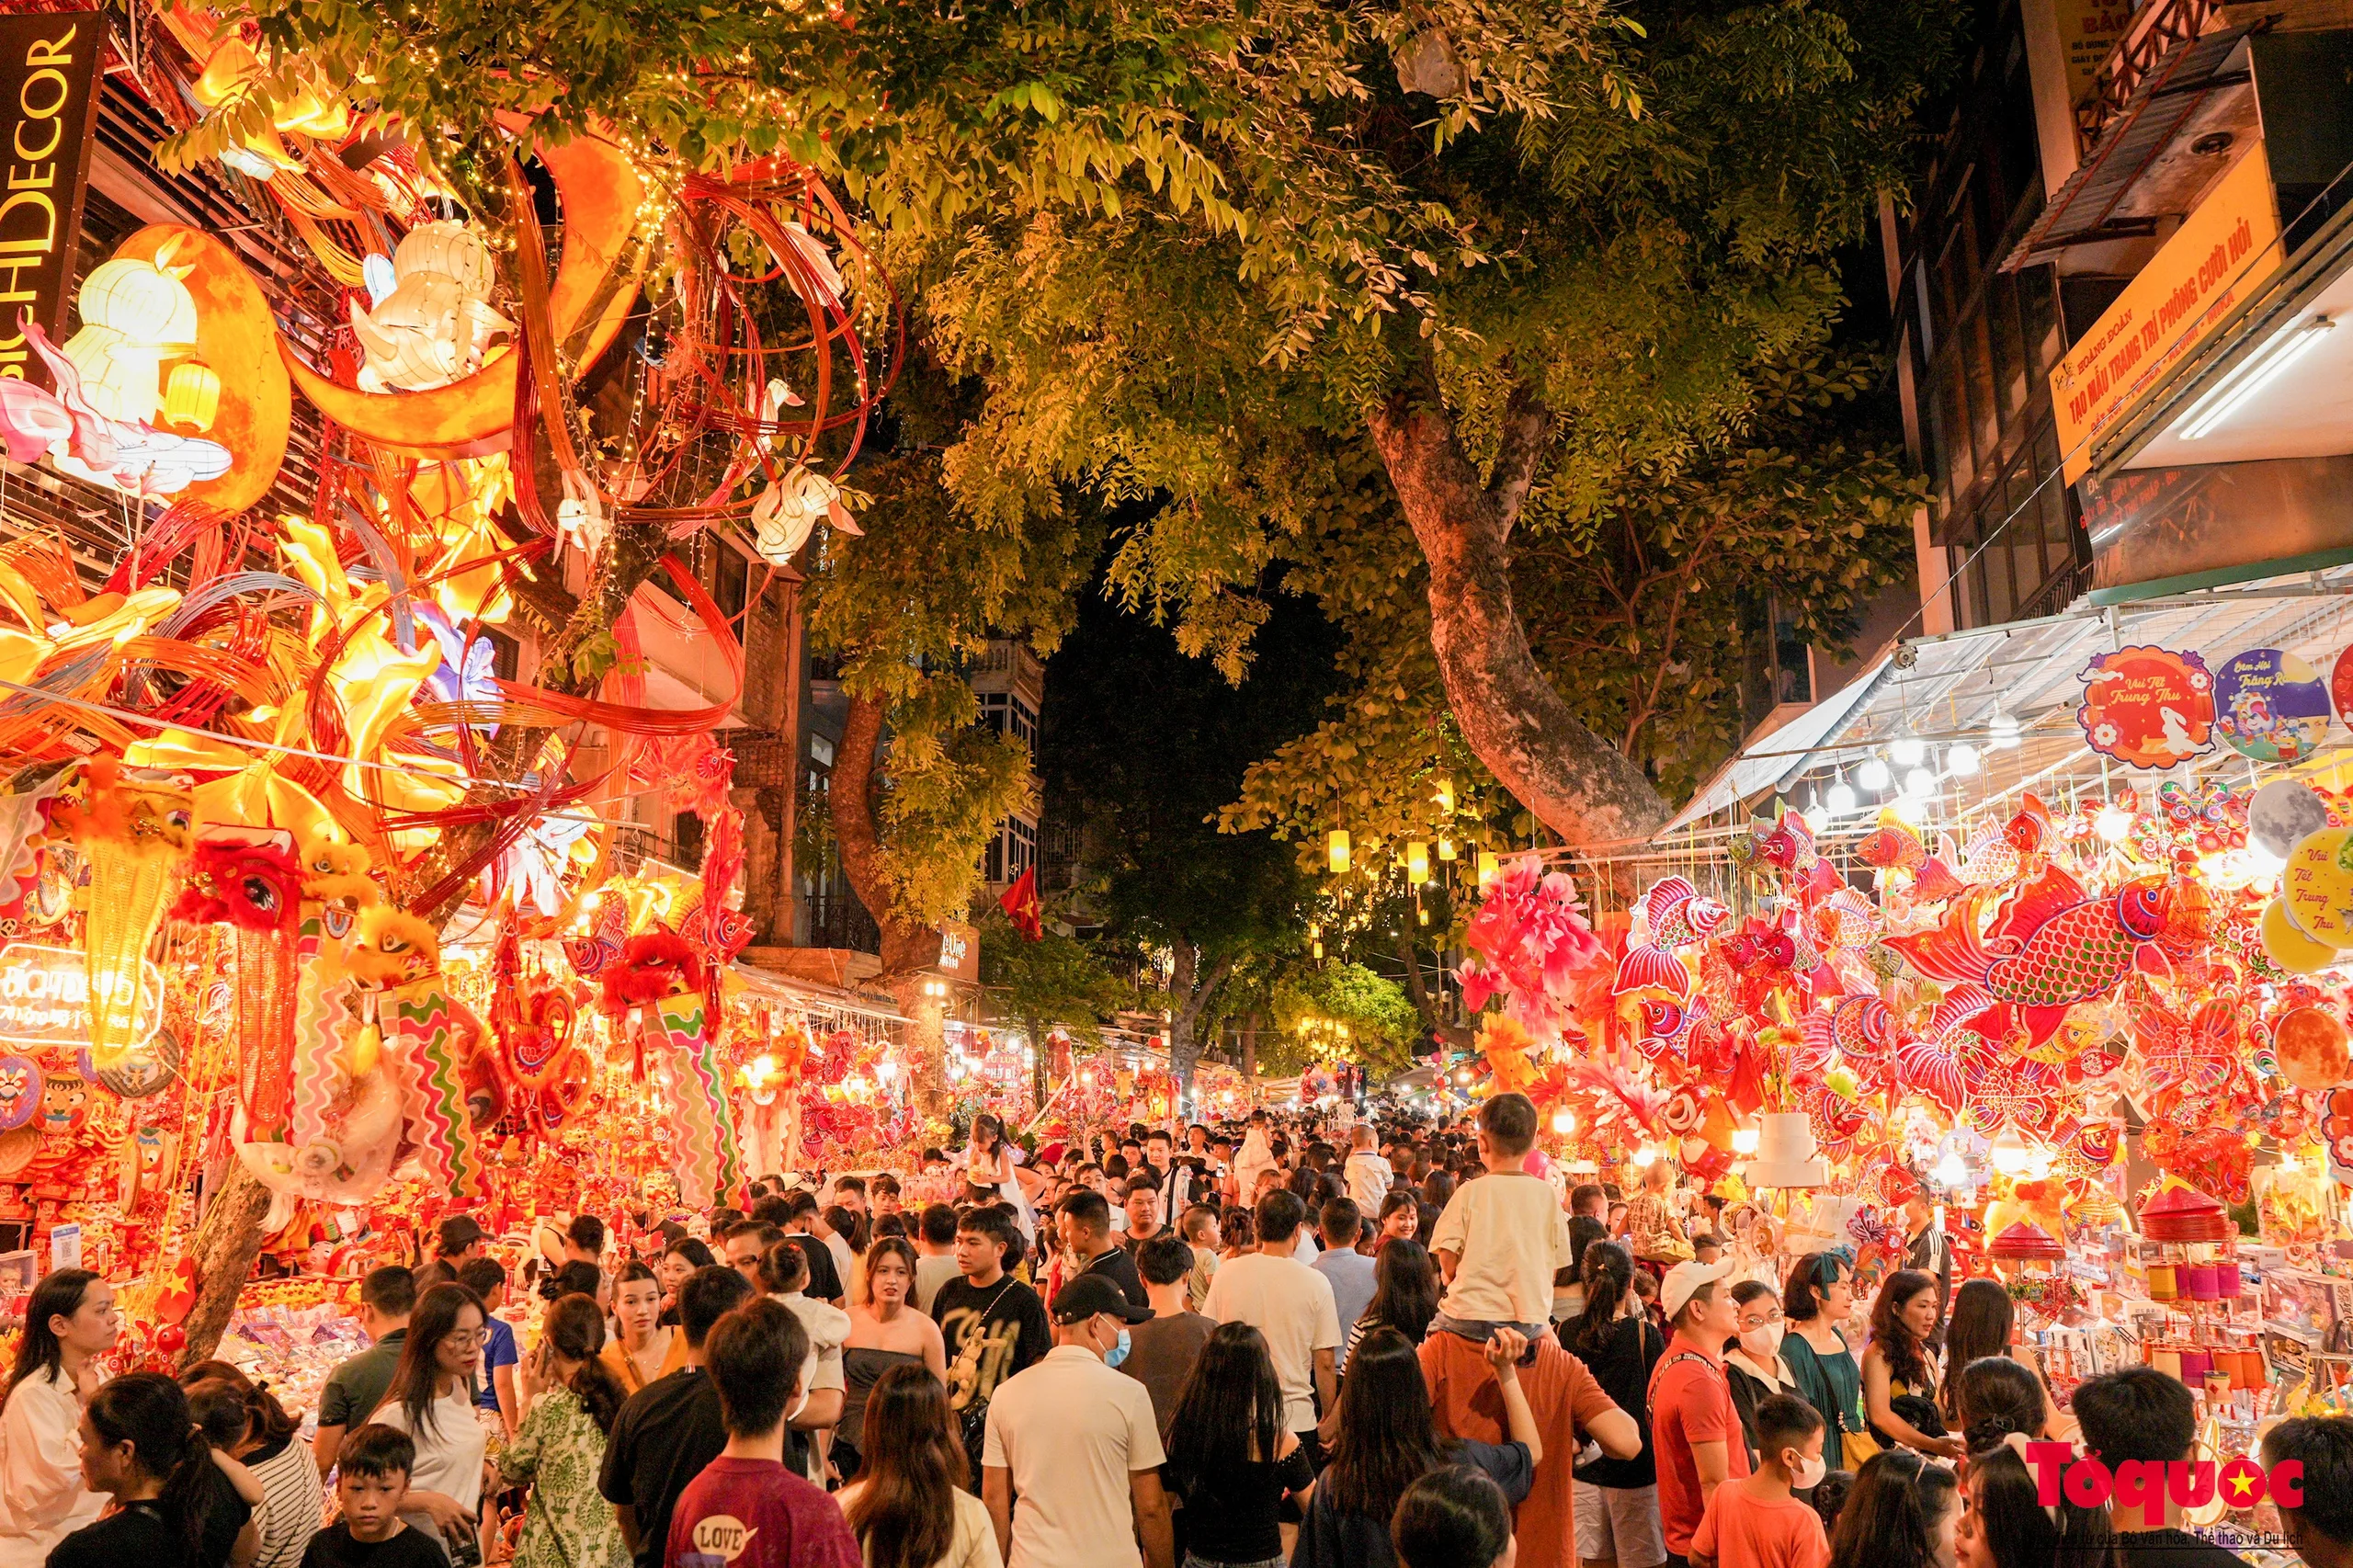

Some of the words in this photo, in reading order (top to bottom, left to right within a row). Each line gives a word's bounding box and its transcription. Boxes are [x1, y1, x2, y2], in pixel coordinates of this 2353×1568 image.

[2069, 390, 2087, 425] TẠO
[2086, 364, 2109, 408] MẪU
[2109, 335, 2142, 384] TRANG
[2140, 309, 2159, 352] TRÍ
[2228, 216, 2253, 266] HỎI
[2125, 677, 2146, 690] Vui
[2147, 676, 2165, 689] Tết
[2110, 688, 2151, 707] Trung
[2154, 687, 2182, 704] Thu
[2307, 848, 2328, 861] Vui
[2294, 868, 2313, 881] Tết
[2296, 888, 2329, 911] Trung
[2313, 915, 2335, 929] Thu
[700, 1526, 743, 1551] LOVE
